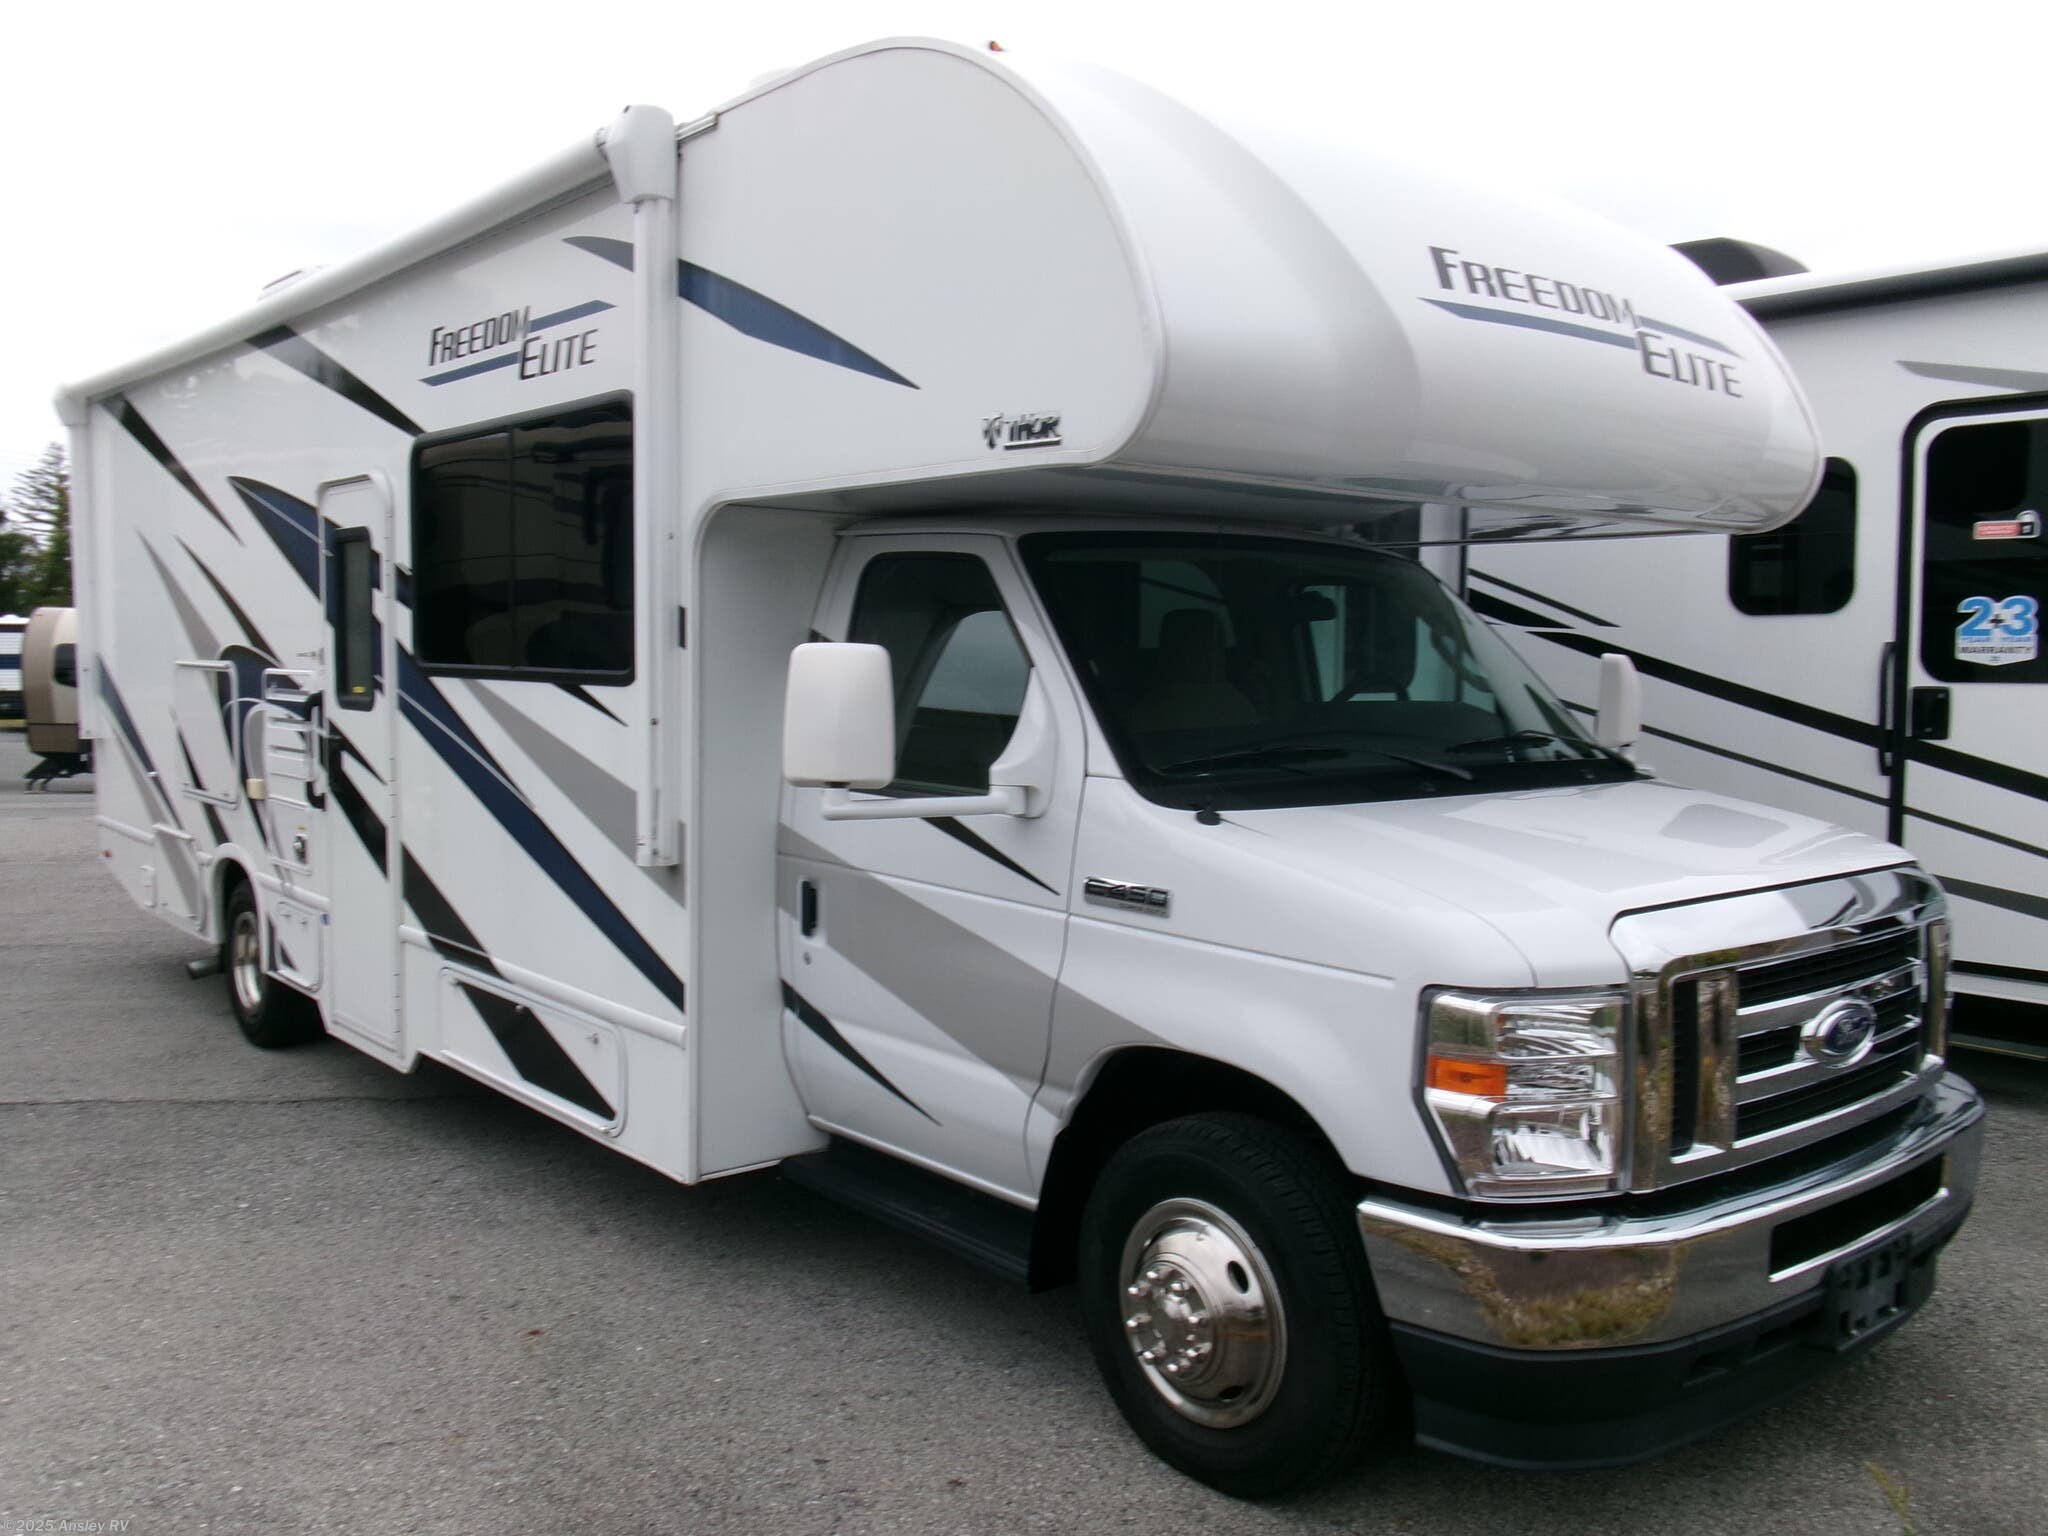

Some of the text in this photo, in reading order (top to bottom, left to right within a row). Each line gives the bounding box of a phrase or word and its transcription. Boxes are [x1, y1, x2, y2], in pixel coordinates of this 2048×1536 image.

[1428, 245, 1640, 331] FREEDOM
[429, 305, 531, 366] FREEDOM
[519, 328, 598, 380] ELITE
[1637, 329, 1744, 399] ELITE
